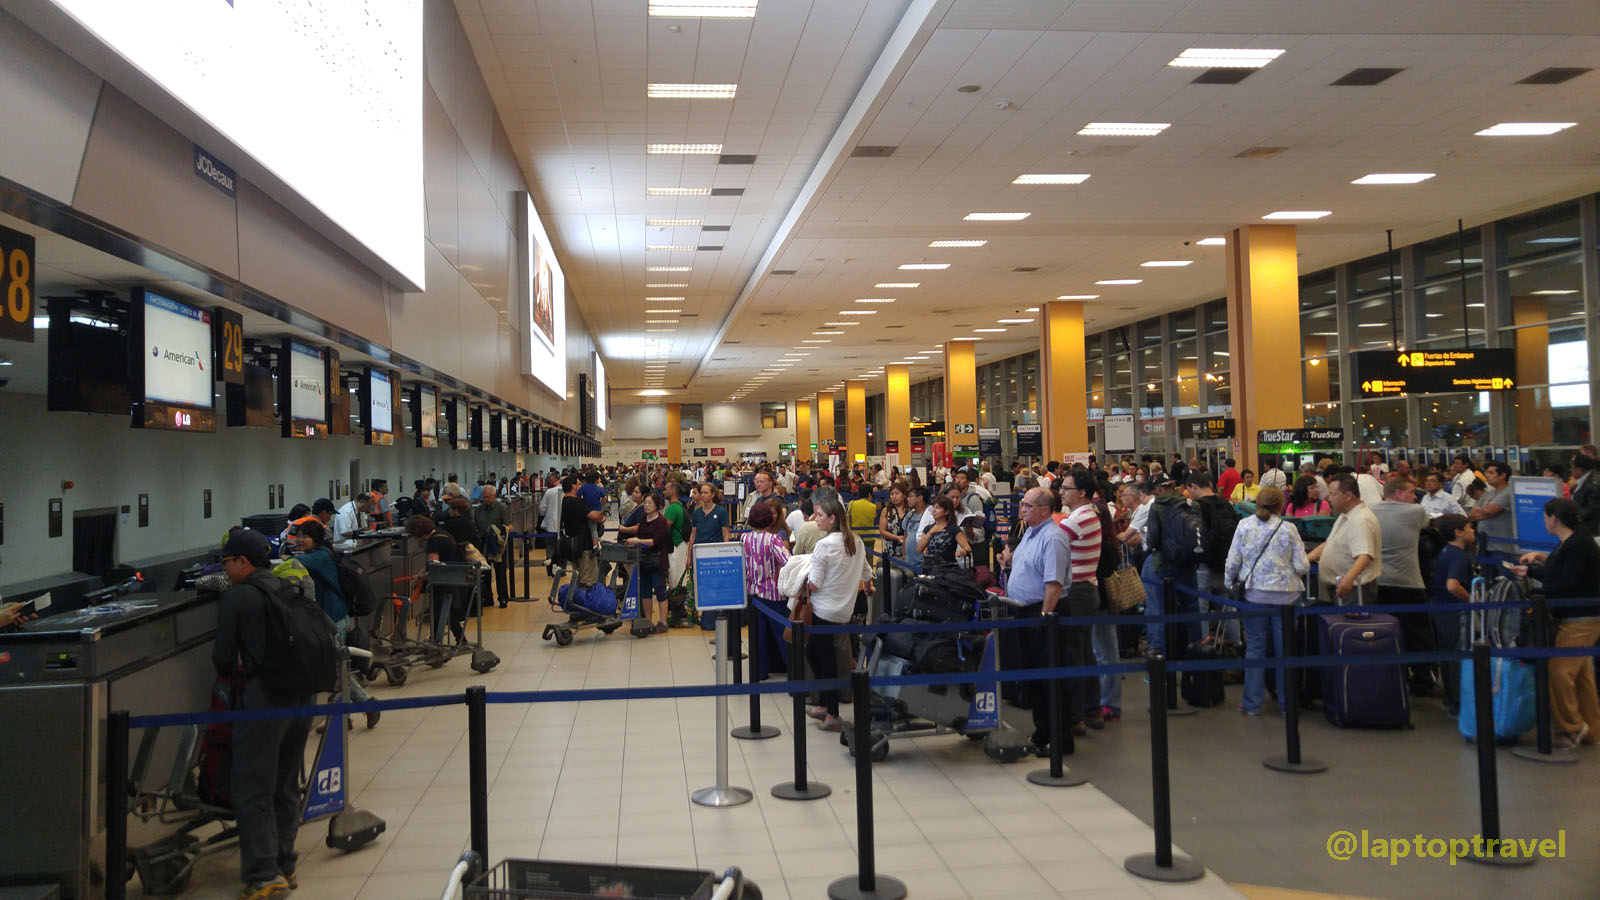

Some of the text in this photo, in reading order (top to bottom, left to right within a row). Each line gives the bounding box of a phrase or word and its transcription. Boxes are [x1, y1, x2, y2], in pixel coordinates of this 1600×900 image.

[197, 152, 234, 192] JCDecaux
[0, 246, 30, 323] 8
[164, 348, 195, 366] American
[224, 321, 243, 373] 29
[1262, 430, 1295, 442] TrueStar
[1310, 431, 1341, 439] TrueStar
